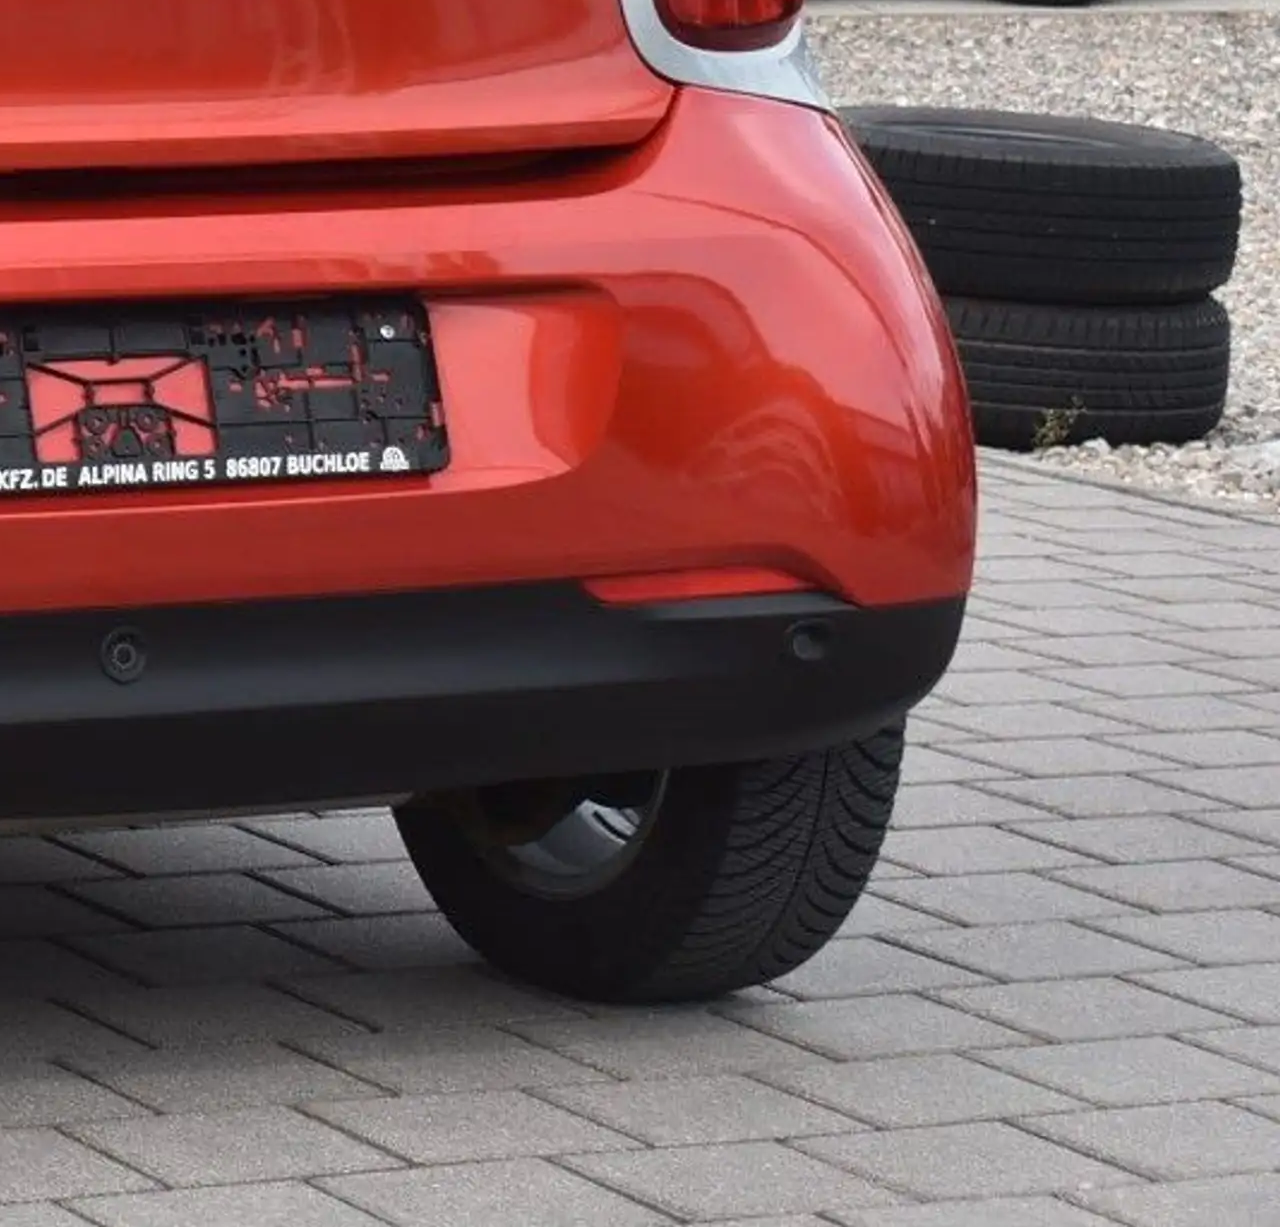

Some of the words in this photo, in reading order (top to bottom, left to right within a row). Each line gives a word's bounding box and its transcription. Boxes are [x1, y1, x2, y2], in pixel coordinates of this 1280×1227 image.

[77, 462, 148, 485] ALPINA
[151, 459, 199, 482] RING
[203, 459, 216, 479] 5
[225, 455, 282, 478] 86807
[286, 451, 370, 474] BUCHLOE
